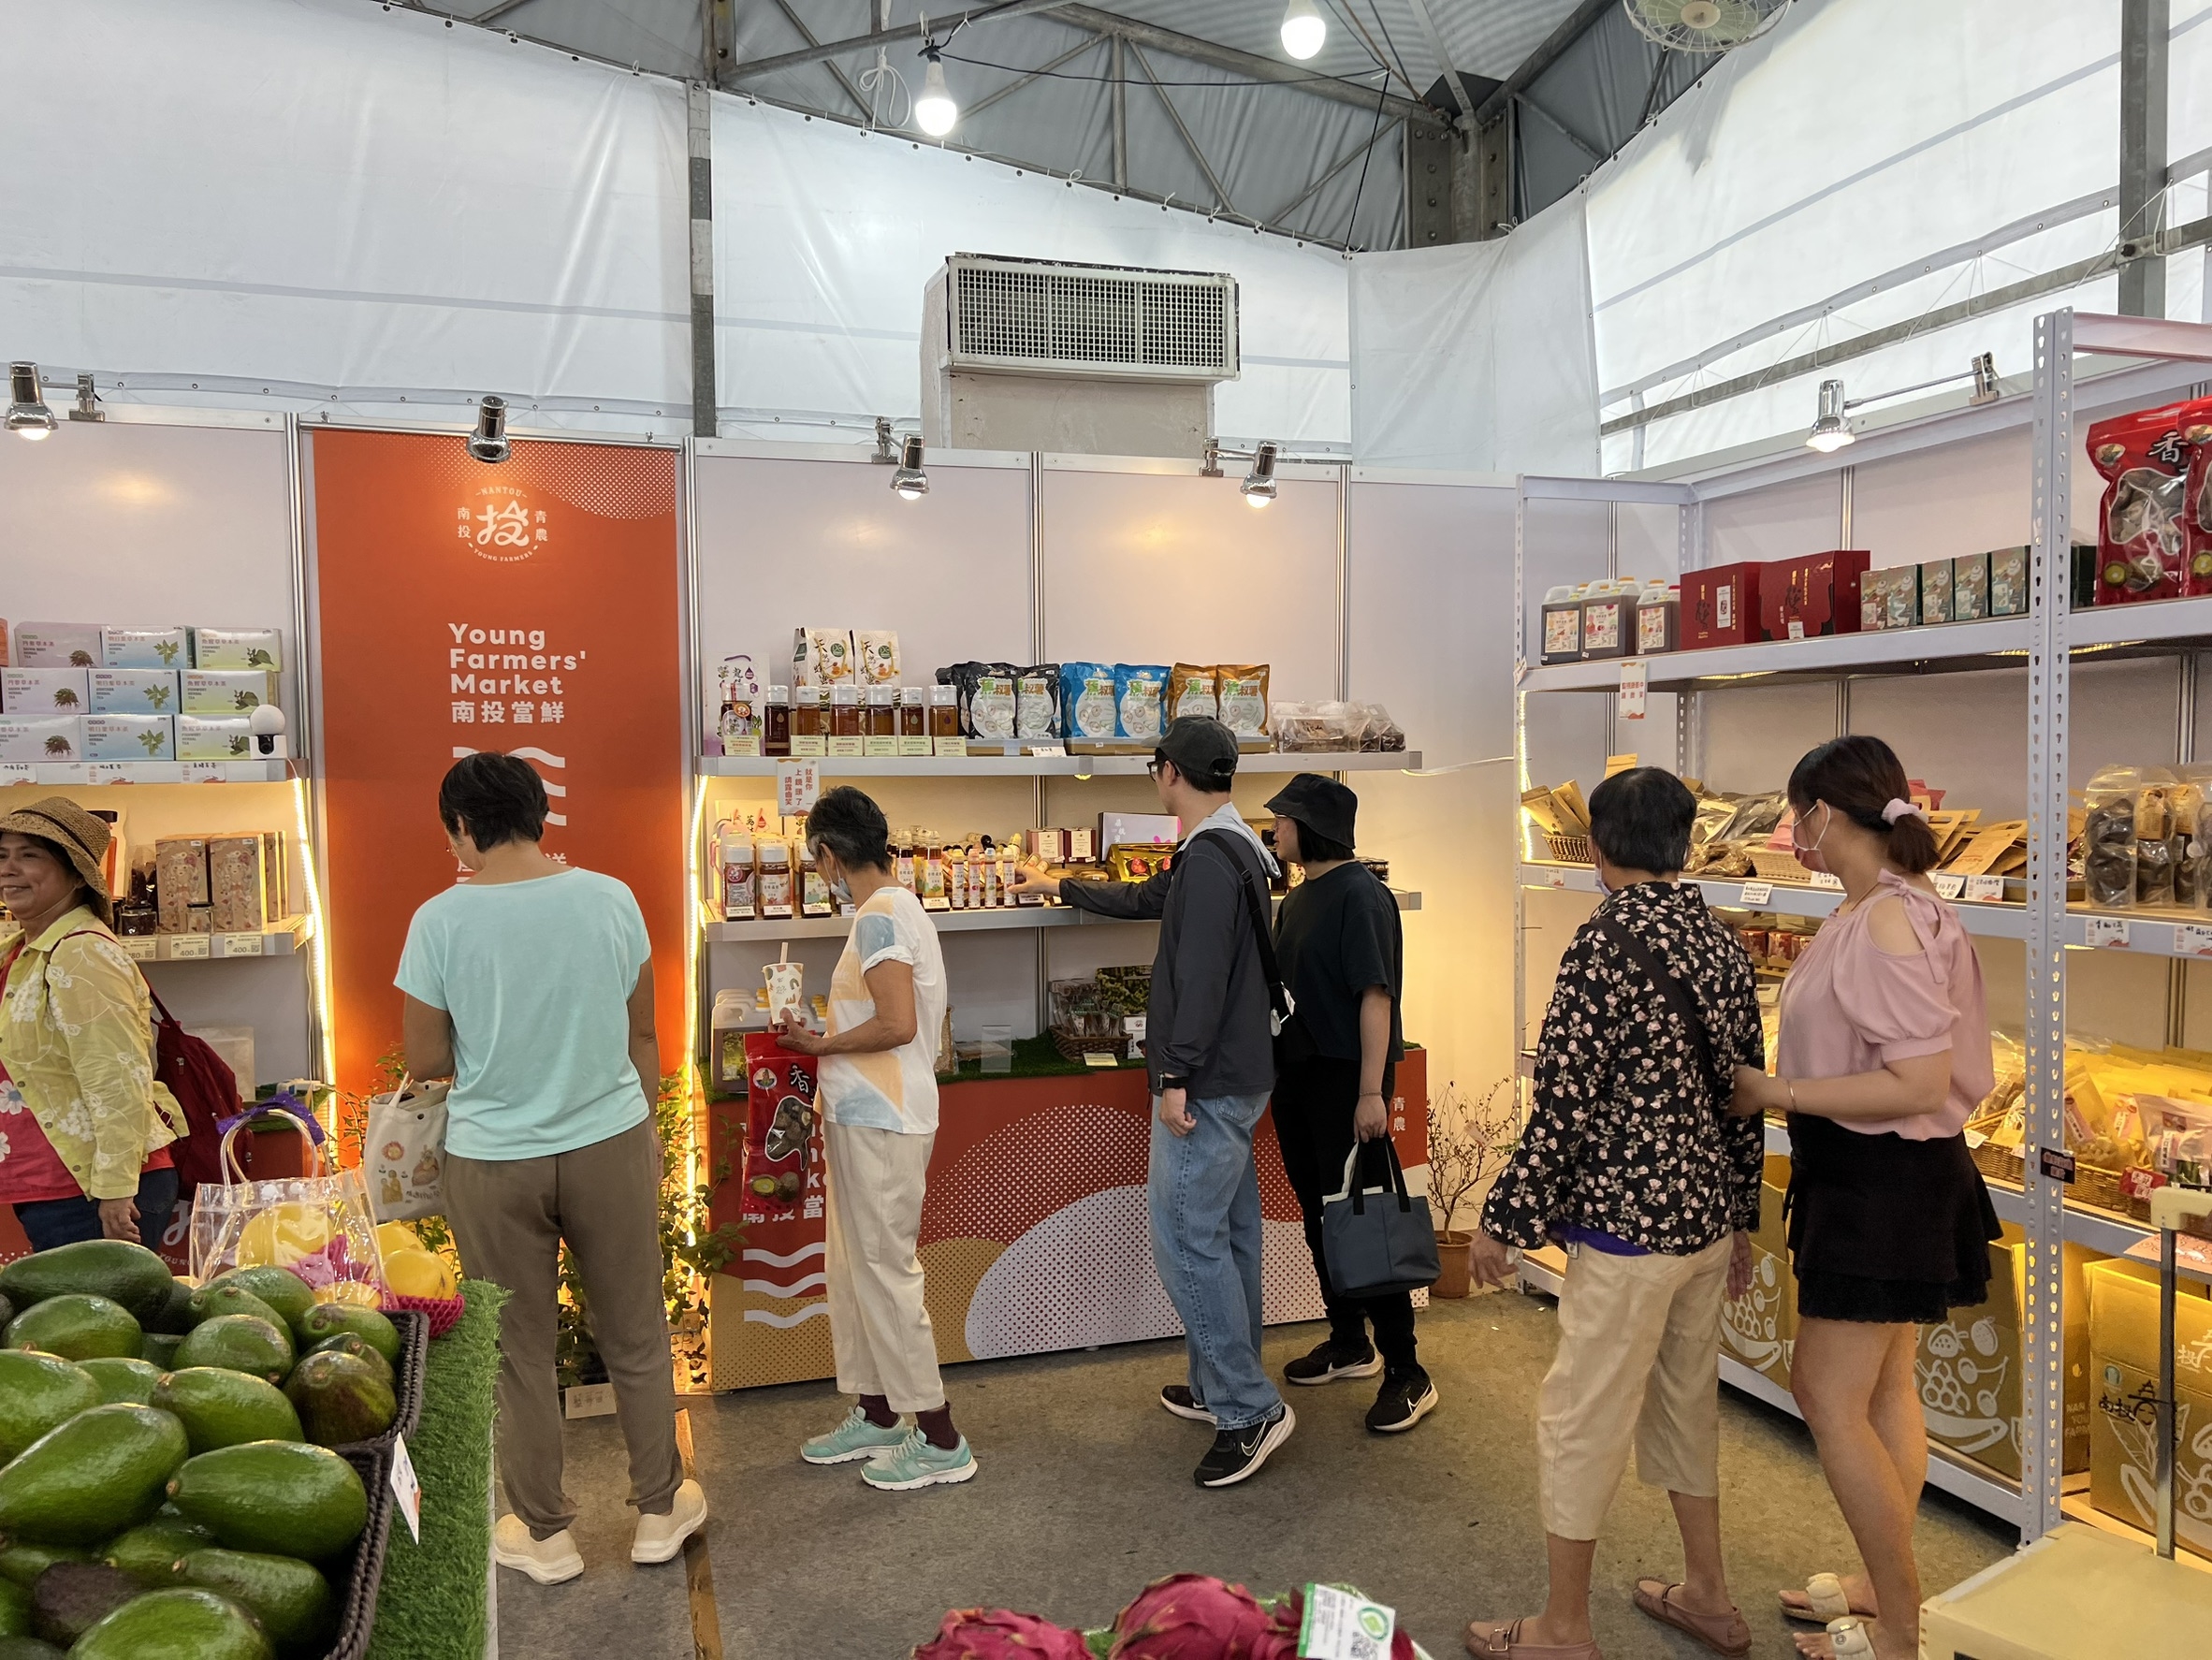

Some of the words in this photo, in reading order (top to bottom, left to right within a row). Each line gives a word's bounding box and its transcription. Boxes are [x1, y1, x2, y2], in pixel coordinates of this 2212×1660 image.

[2147, 430, 2190, 472] 香
[480, 486, 522, 497] NANTOU
[458, 506, 471, 539] 南投
[534, 510, 548, 542] 青農
[473, 548, 498, 561] YOUNG
[500, 550, 533, 561] FARMERS
[447, 622, 546, 651] Young
[449, 648, 587, 671] Farmers'
[450, 673, 564, 695] Market
[450, 700, 565, 724] 南投當鮮
[794, 768, 803, 806] 上鏡頭了
[805, 767, 813, 791] 就是你
[1392, 1097, 1405, 1131] 青農
